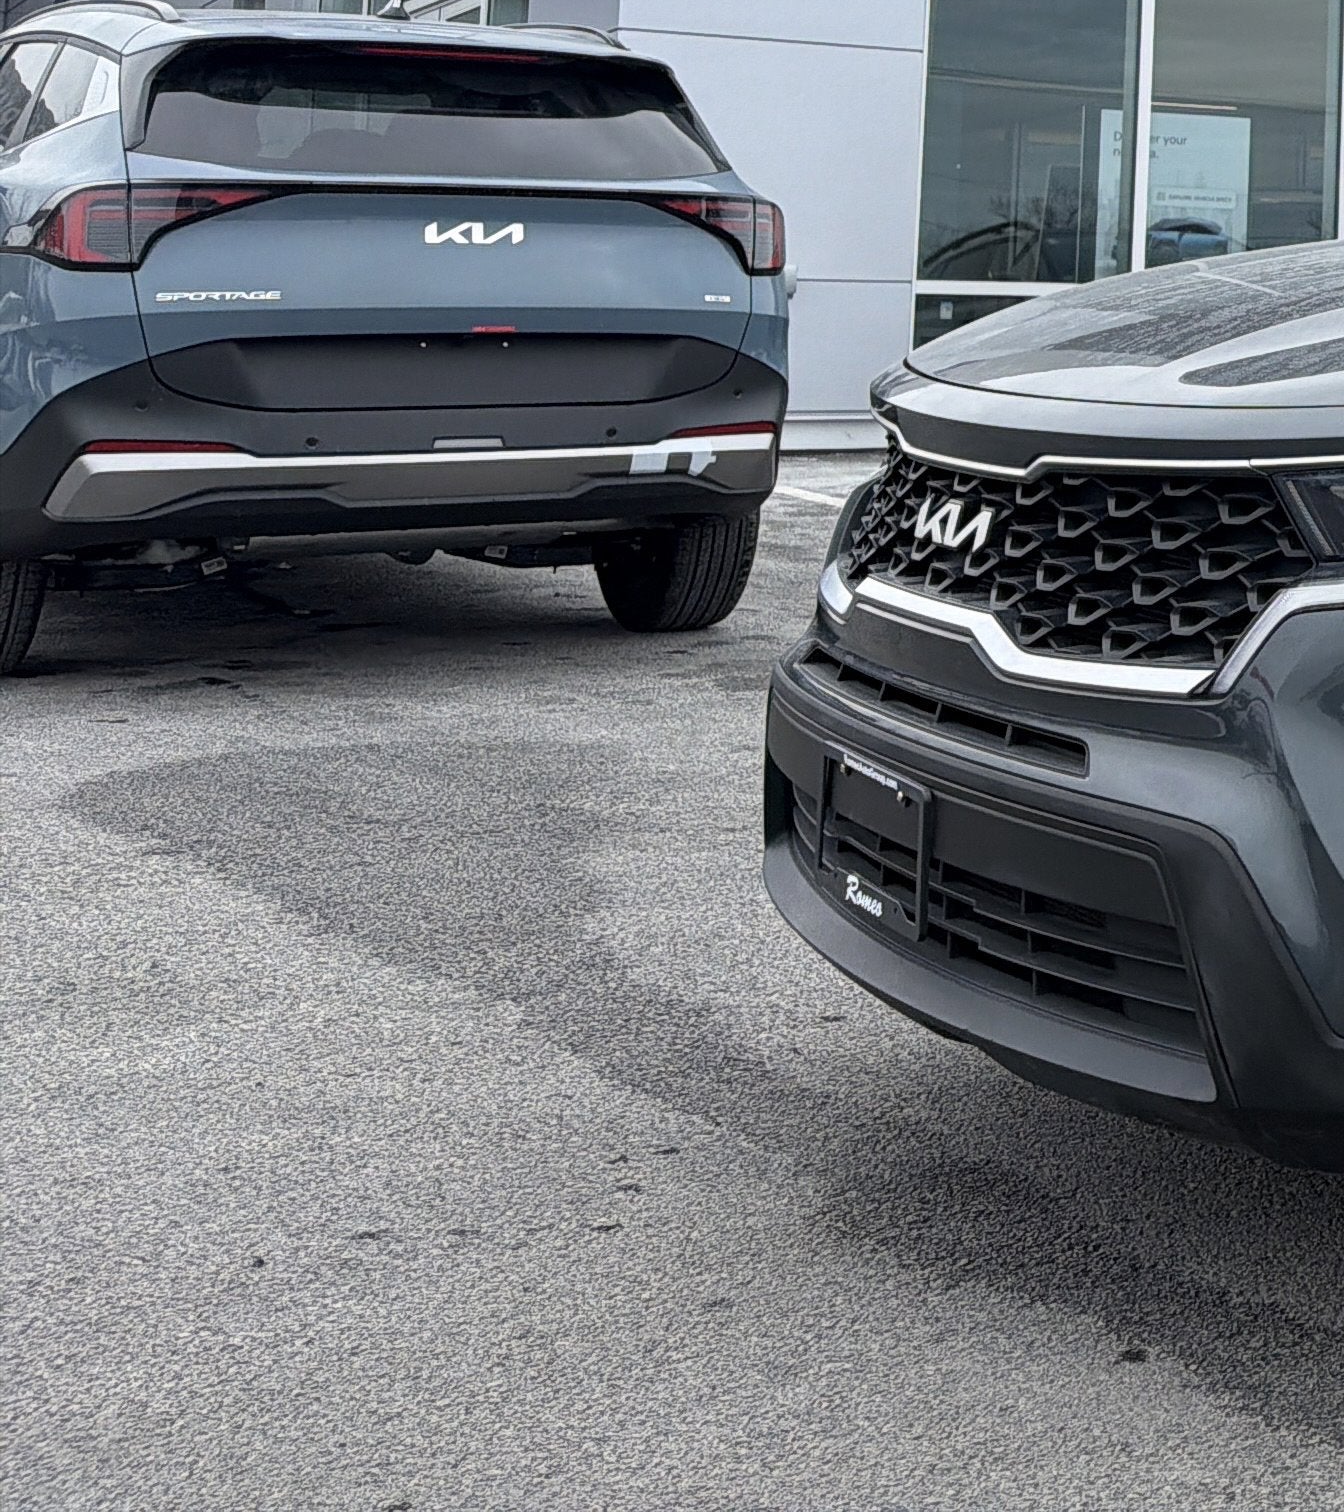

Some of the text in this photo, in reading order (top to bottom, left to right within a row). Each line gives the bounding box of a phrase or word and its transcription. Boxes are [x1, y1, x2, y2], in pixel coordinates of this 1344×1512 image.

[1163, 135, 1187, 146] your
[424, 221, 524, 245] KIA
[155, 290, 282, 302] SPORTAGE
[914, 492, 994, 553] KIA
[845, 874, 883, 918] Romeo
